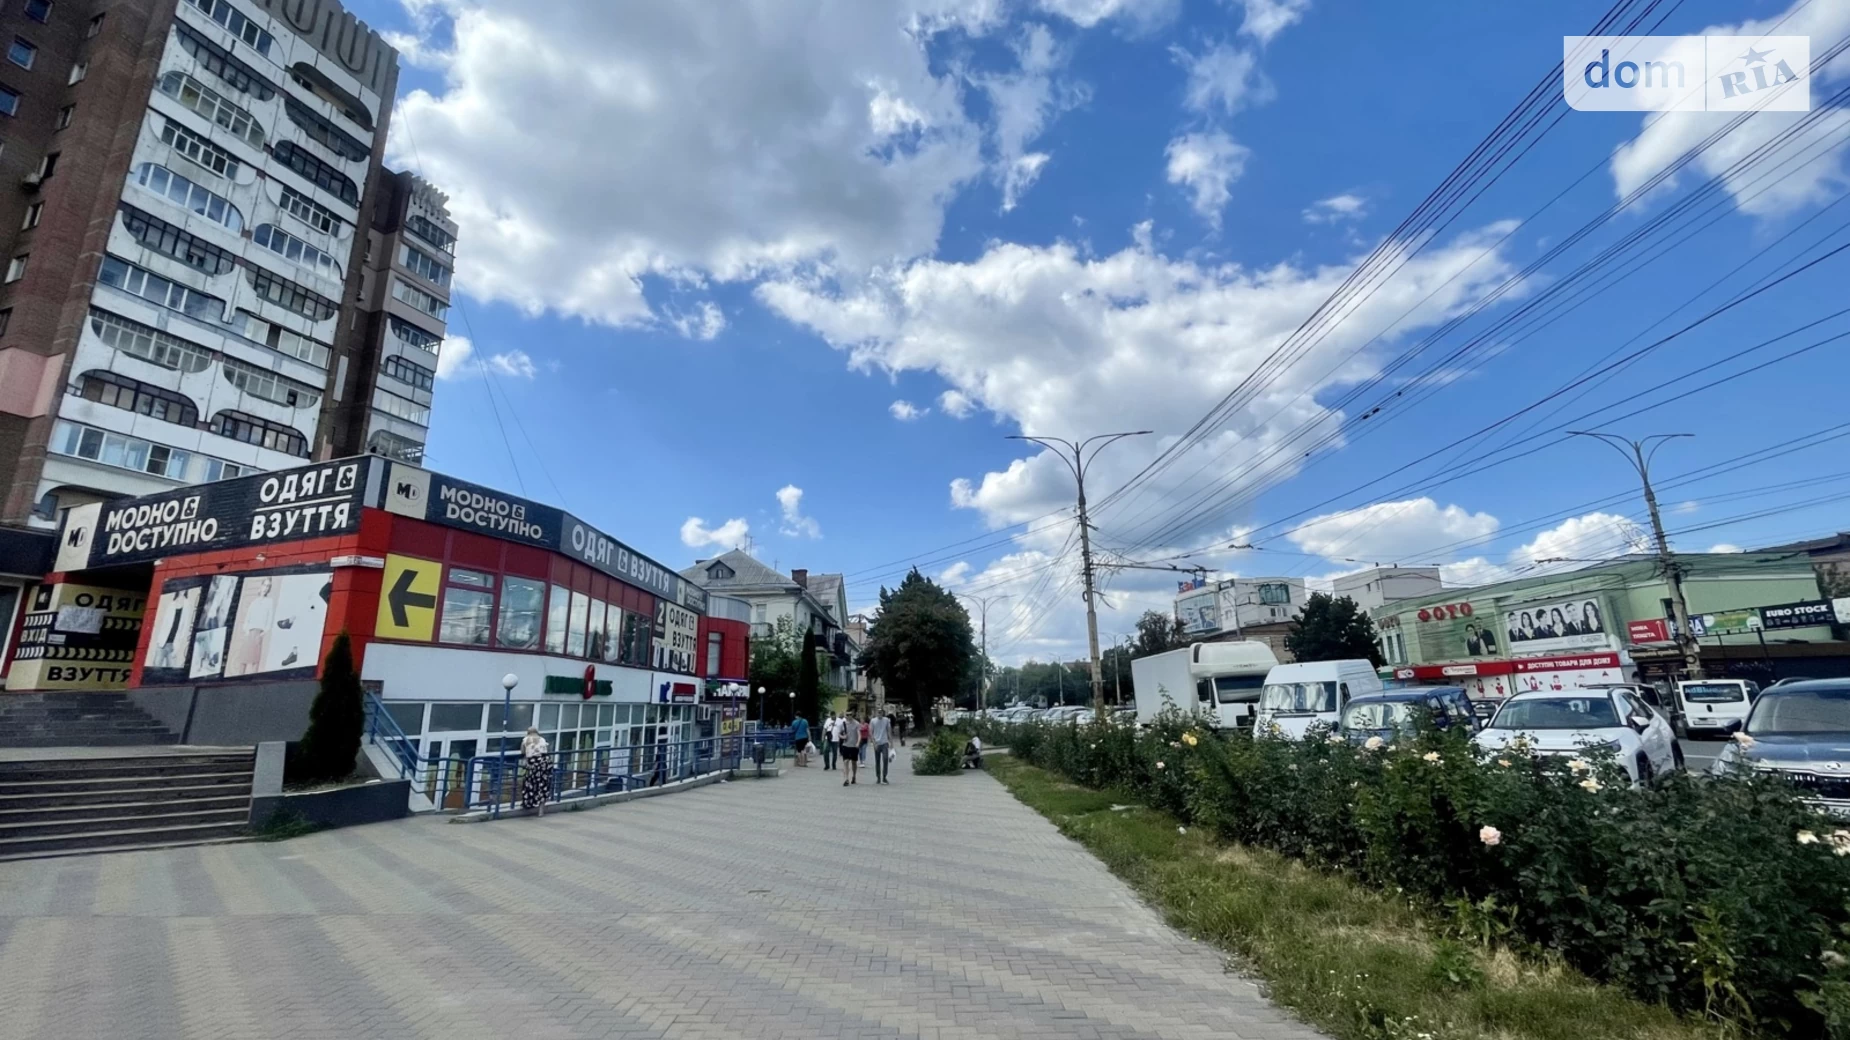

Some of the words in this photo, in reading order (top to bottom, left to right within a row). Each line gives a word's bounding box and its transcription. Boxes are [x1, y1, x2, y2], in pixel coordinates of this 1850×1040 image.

[260, 468, 333, 503] ОДЯГ
[250, 502, 350, 540] ВЗУТТЯ
[571, 524, 615, 565] ОДЯГ
[630, 554, 669, 593] ВЗУТТЯ
[75, 592, 144, 612] ОДЯГ
[1417, 602, 1472, 622] ФОТО
[1766, 608, 1792, 618] EURO
[1794, 604, 1828, 616] STOCK
[657, 602, 665, 624] 2
[669, 607, 688, 629] ОДЯГ
[20, 628, 48, 644] ВХІД
[672, 631, 697, 653] ВЗУТТЯ
[1555, 659, 1578, 667] ТОВАРИ
[1579, 658, 1592, 666] ДЛЯ
[47, 666, 132, 682] ВЗУТТЯ
